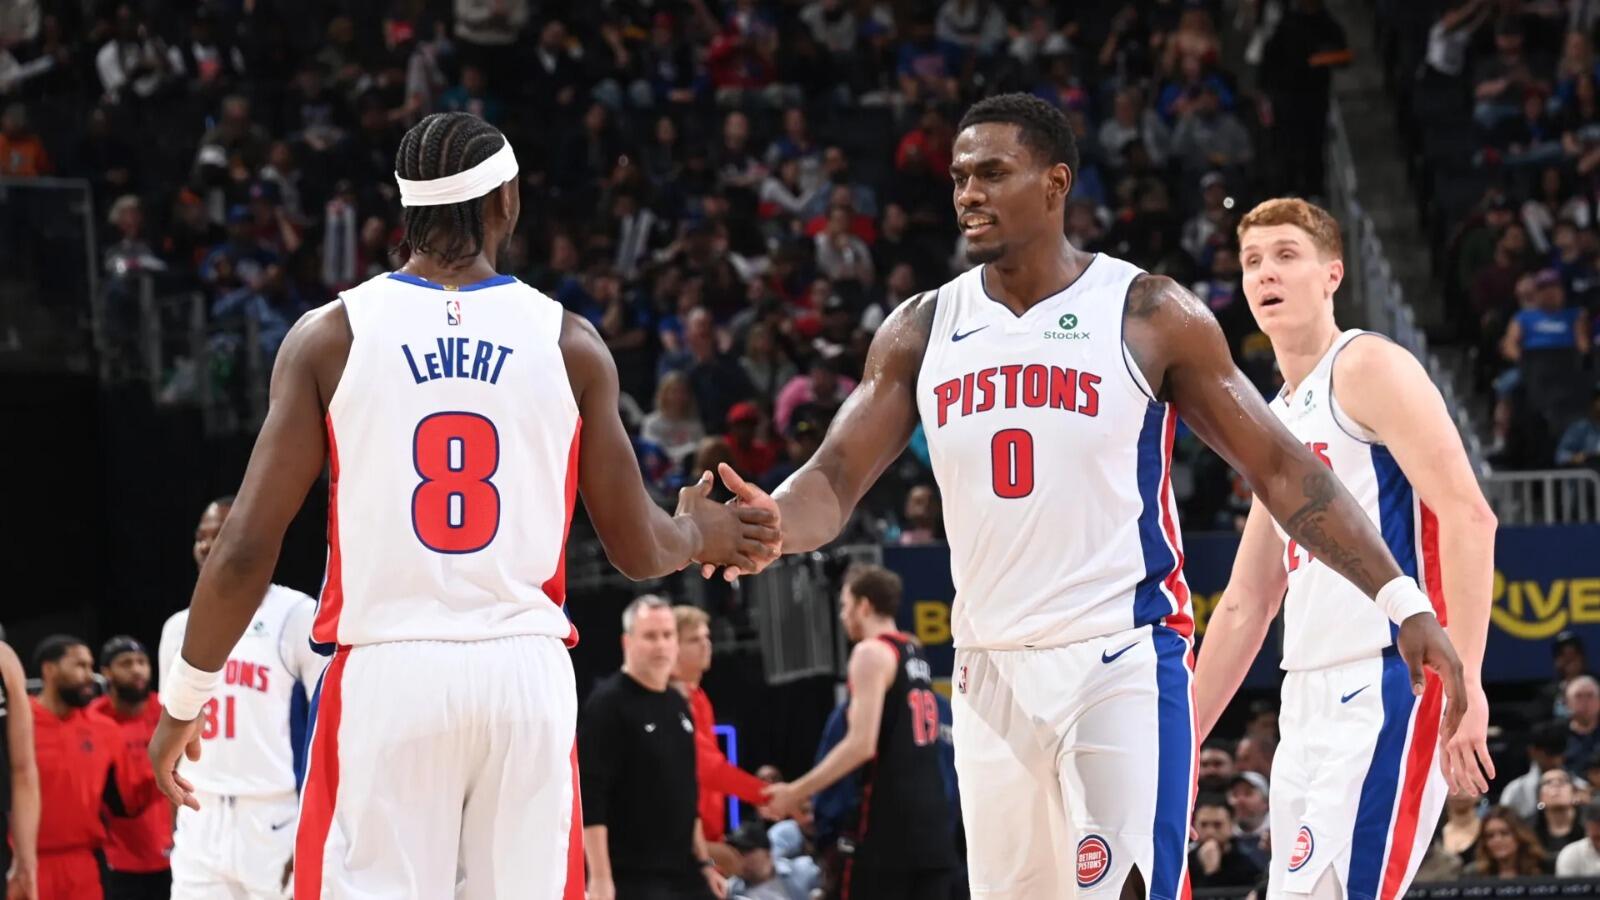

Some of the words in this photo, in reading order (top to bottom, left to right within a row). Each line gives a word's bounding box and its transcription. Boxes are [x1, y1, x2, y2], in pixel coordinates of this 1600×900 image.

[401, 337, 514, 385] LeVERT
[1043, 331, 1090, 340] StockX
[933, 364, 1102, 428] PISTONS
[411, 411, 501, 555] 8
[991, 428, 1034, 499] 0
